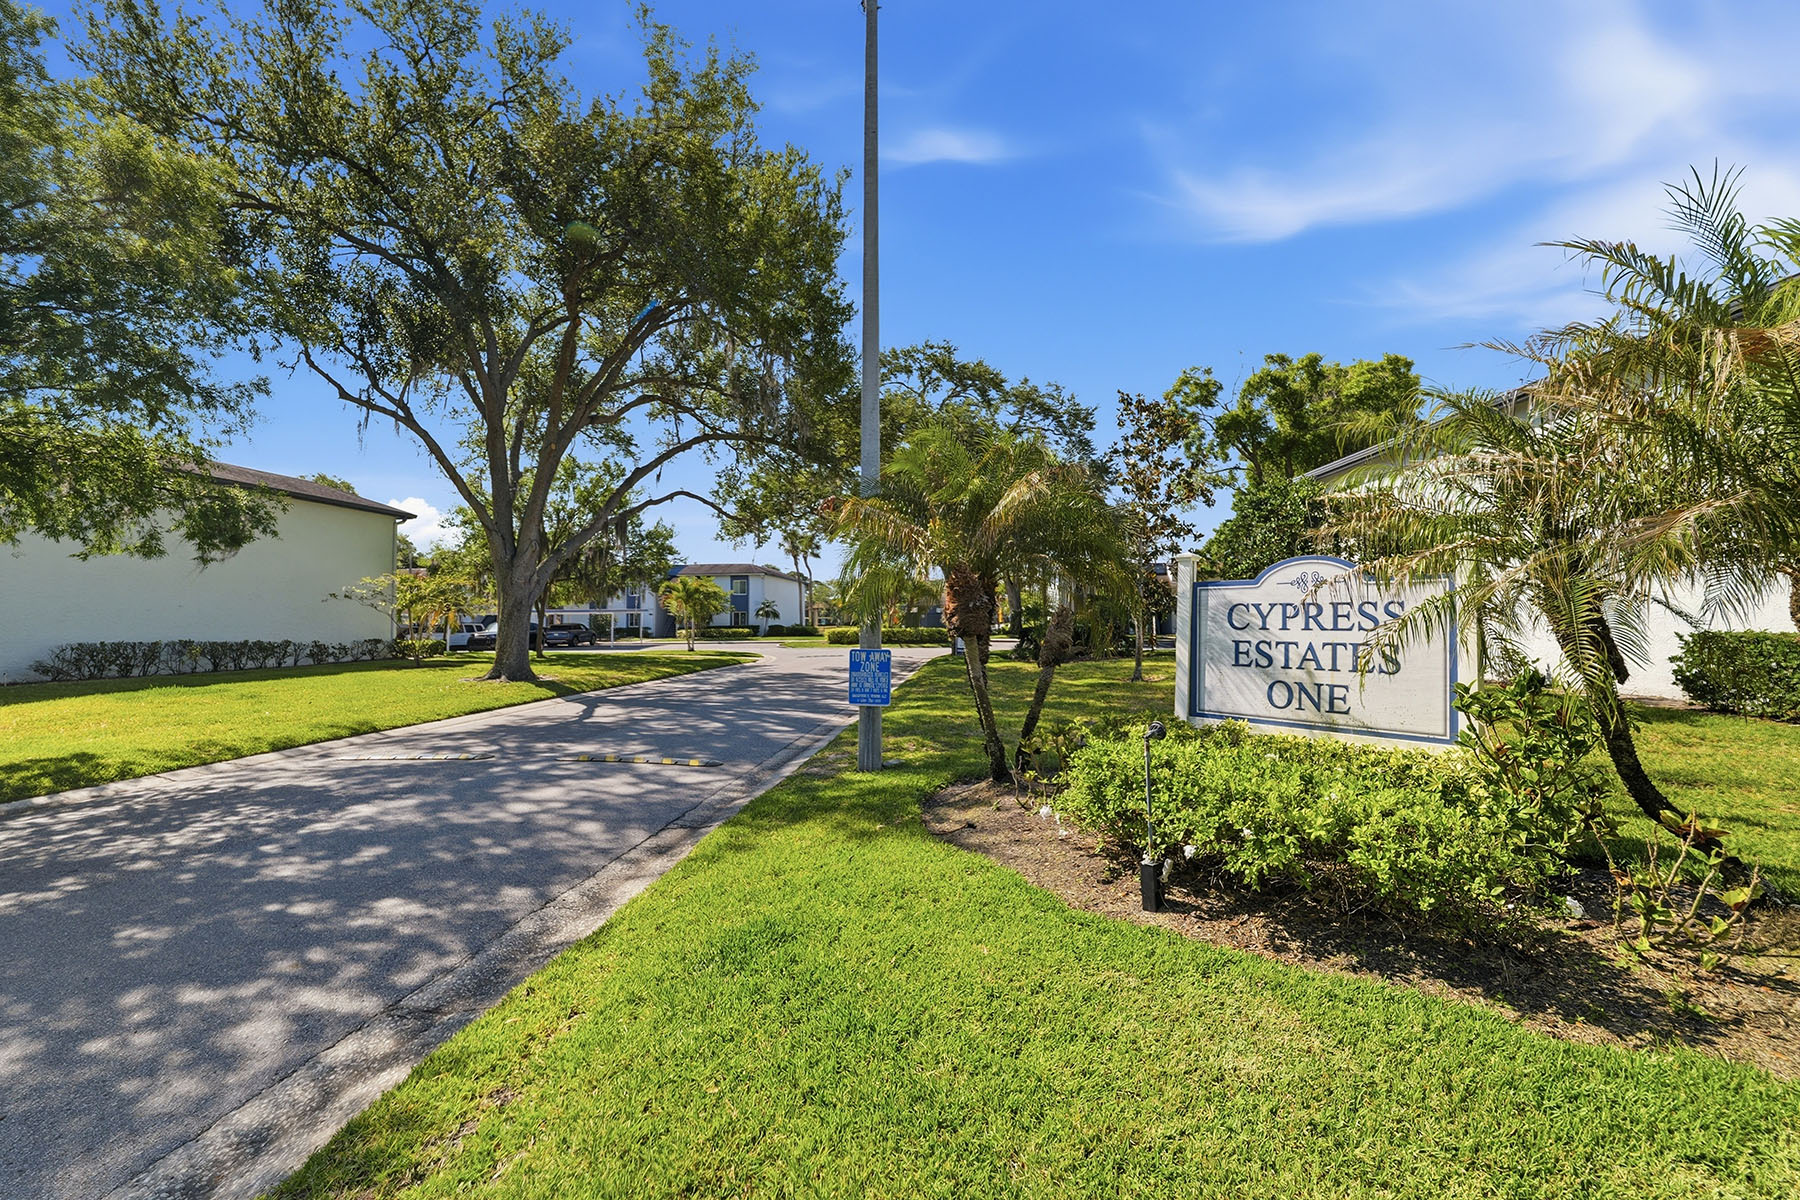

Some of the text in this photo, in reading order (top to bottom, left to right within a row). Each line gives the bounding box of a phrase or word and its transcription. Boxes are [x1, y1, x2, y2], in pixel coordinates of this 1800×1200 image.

[1227, 600, 1406, 632] CYPRESS
[851, 651, 866, 662] TOW
[860, 661, 880, 672] ZONE
[1231, 639, 1401, 675] ESTATES
[1267, 679, 1351, 715] ONE
